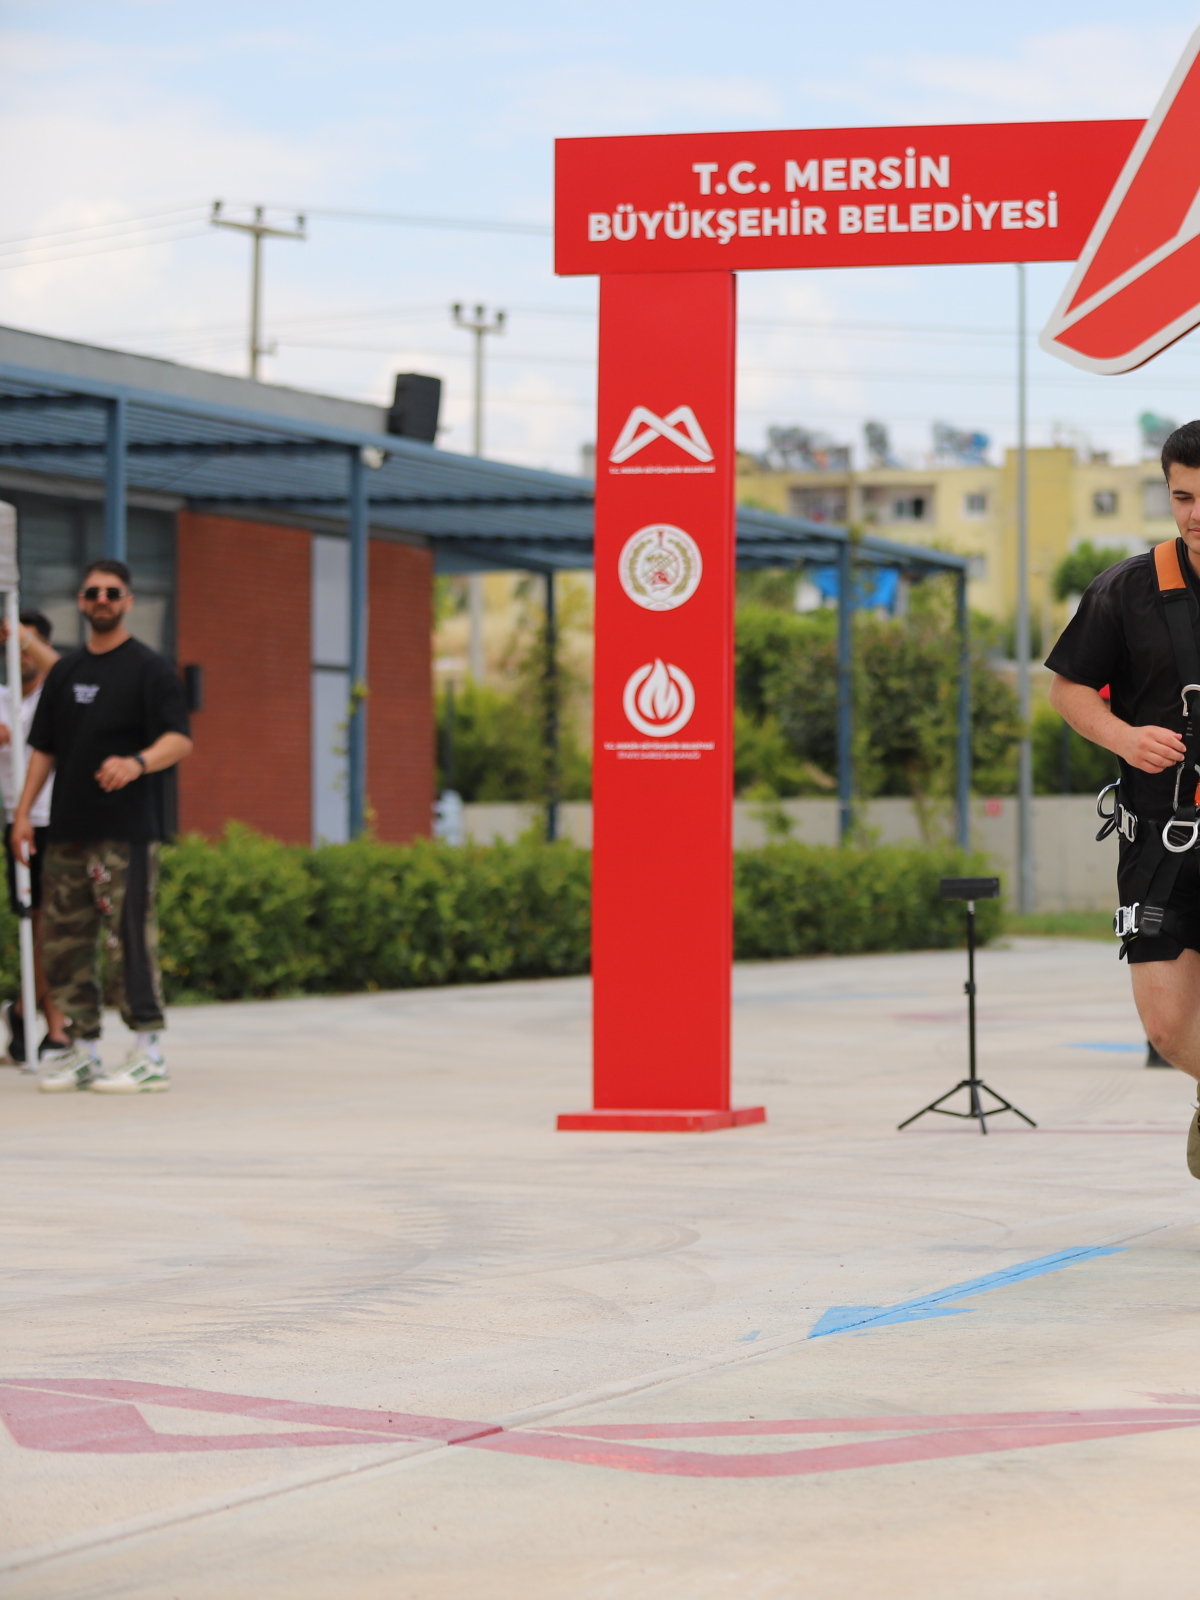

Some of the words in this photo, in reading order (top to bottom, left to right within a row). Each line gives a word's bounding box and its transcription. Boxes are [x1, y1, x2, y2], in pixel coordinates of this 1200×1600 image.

[693, 161, 770, 195] T.C.
[786, 147, 950, 193] MERSİN
[588, 198, 827, 244] BÜYÜKŞEHİR
[838, 191, 1058, 235] BELEDİYESİ
